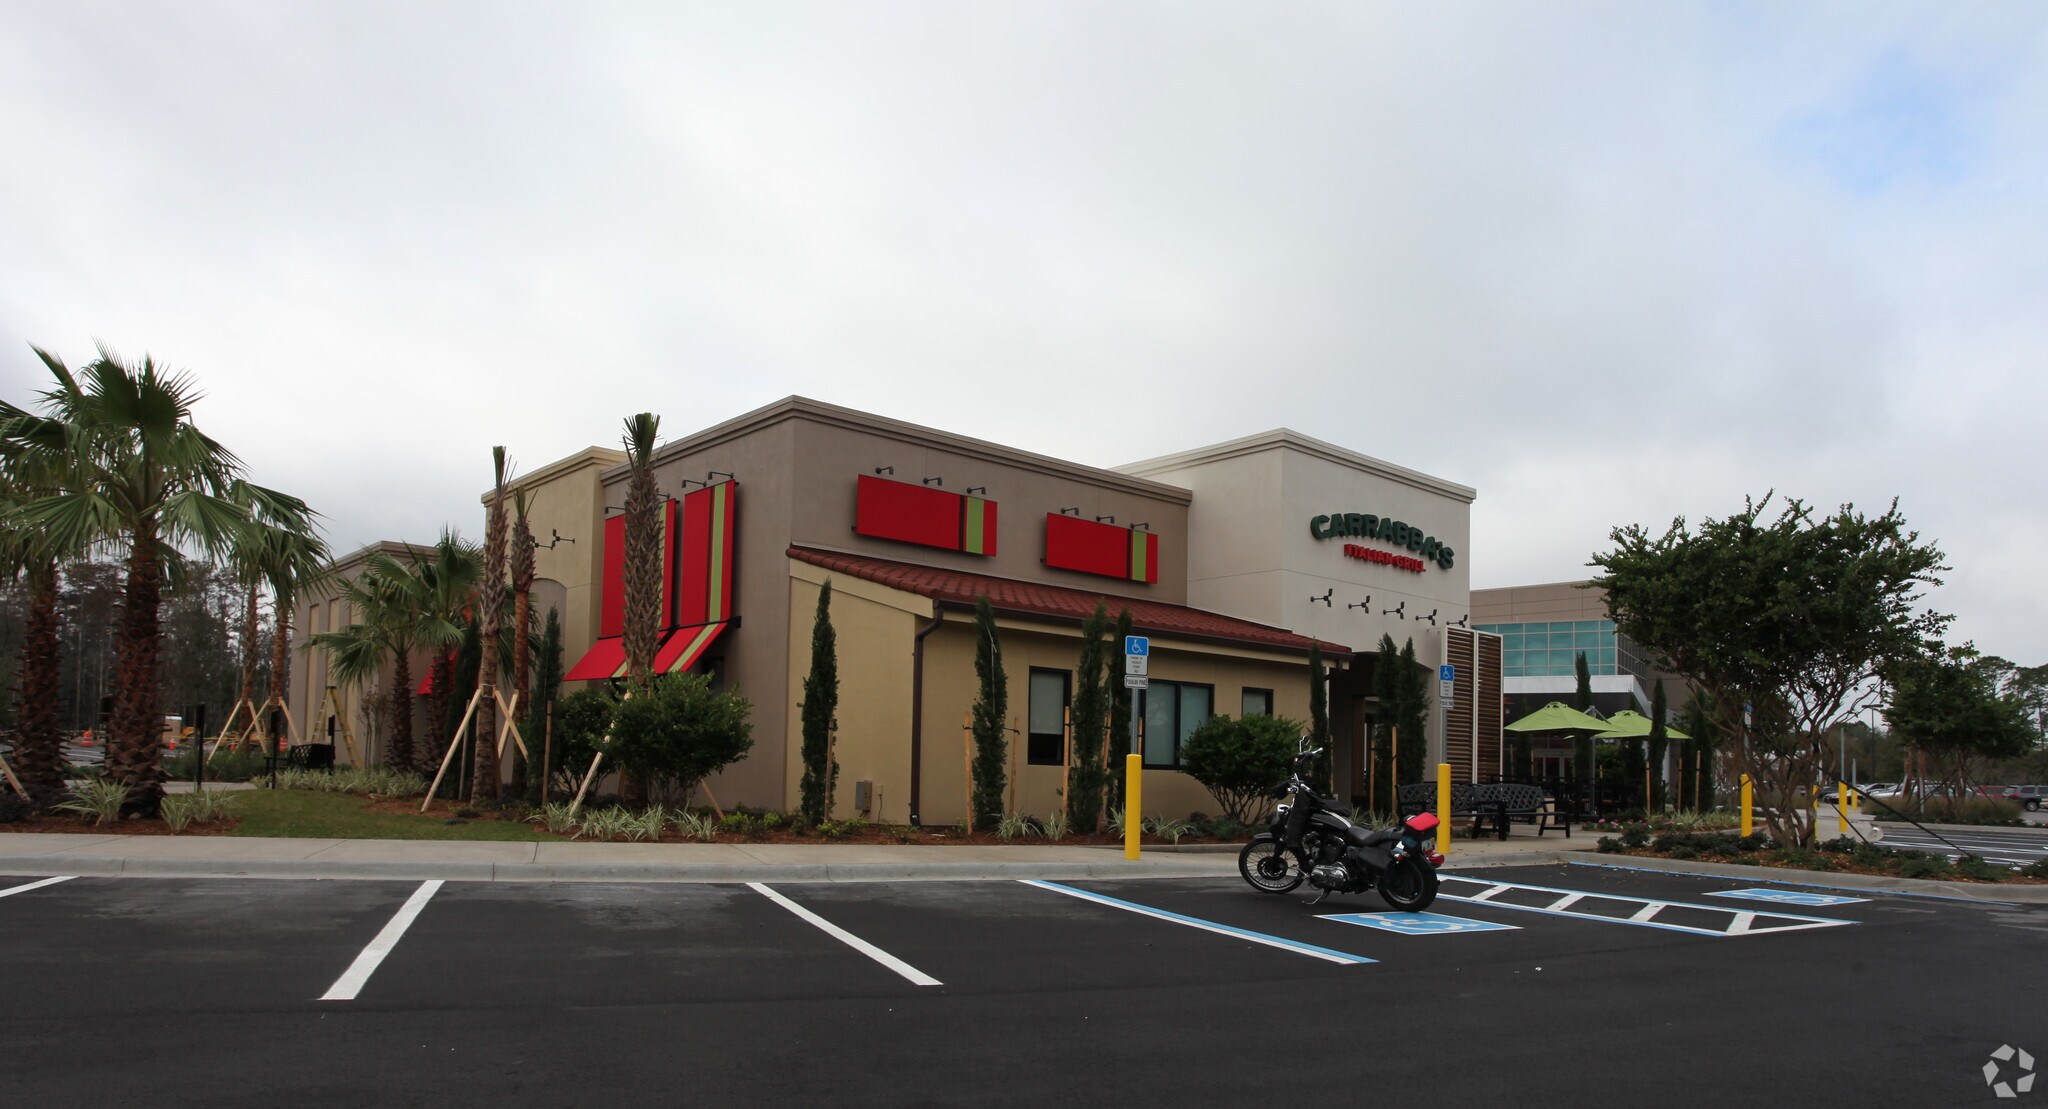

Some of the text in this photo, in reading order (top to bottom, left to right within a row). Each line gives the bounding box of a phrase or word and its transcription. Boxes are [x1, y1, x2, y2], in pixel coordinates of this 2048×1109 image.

[1310, 512, 1454, 569] CARRABBA'S
[1344, 543, 1427, 573] ITALIAN GRILL
